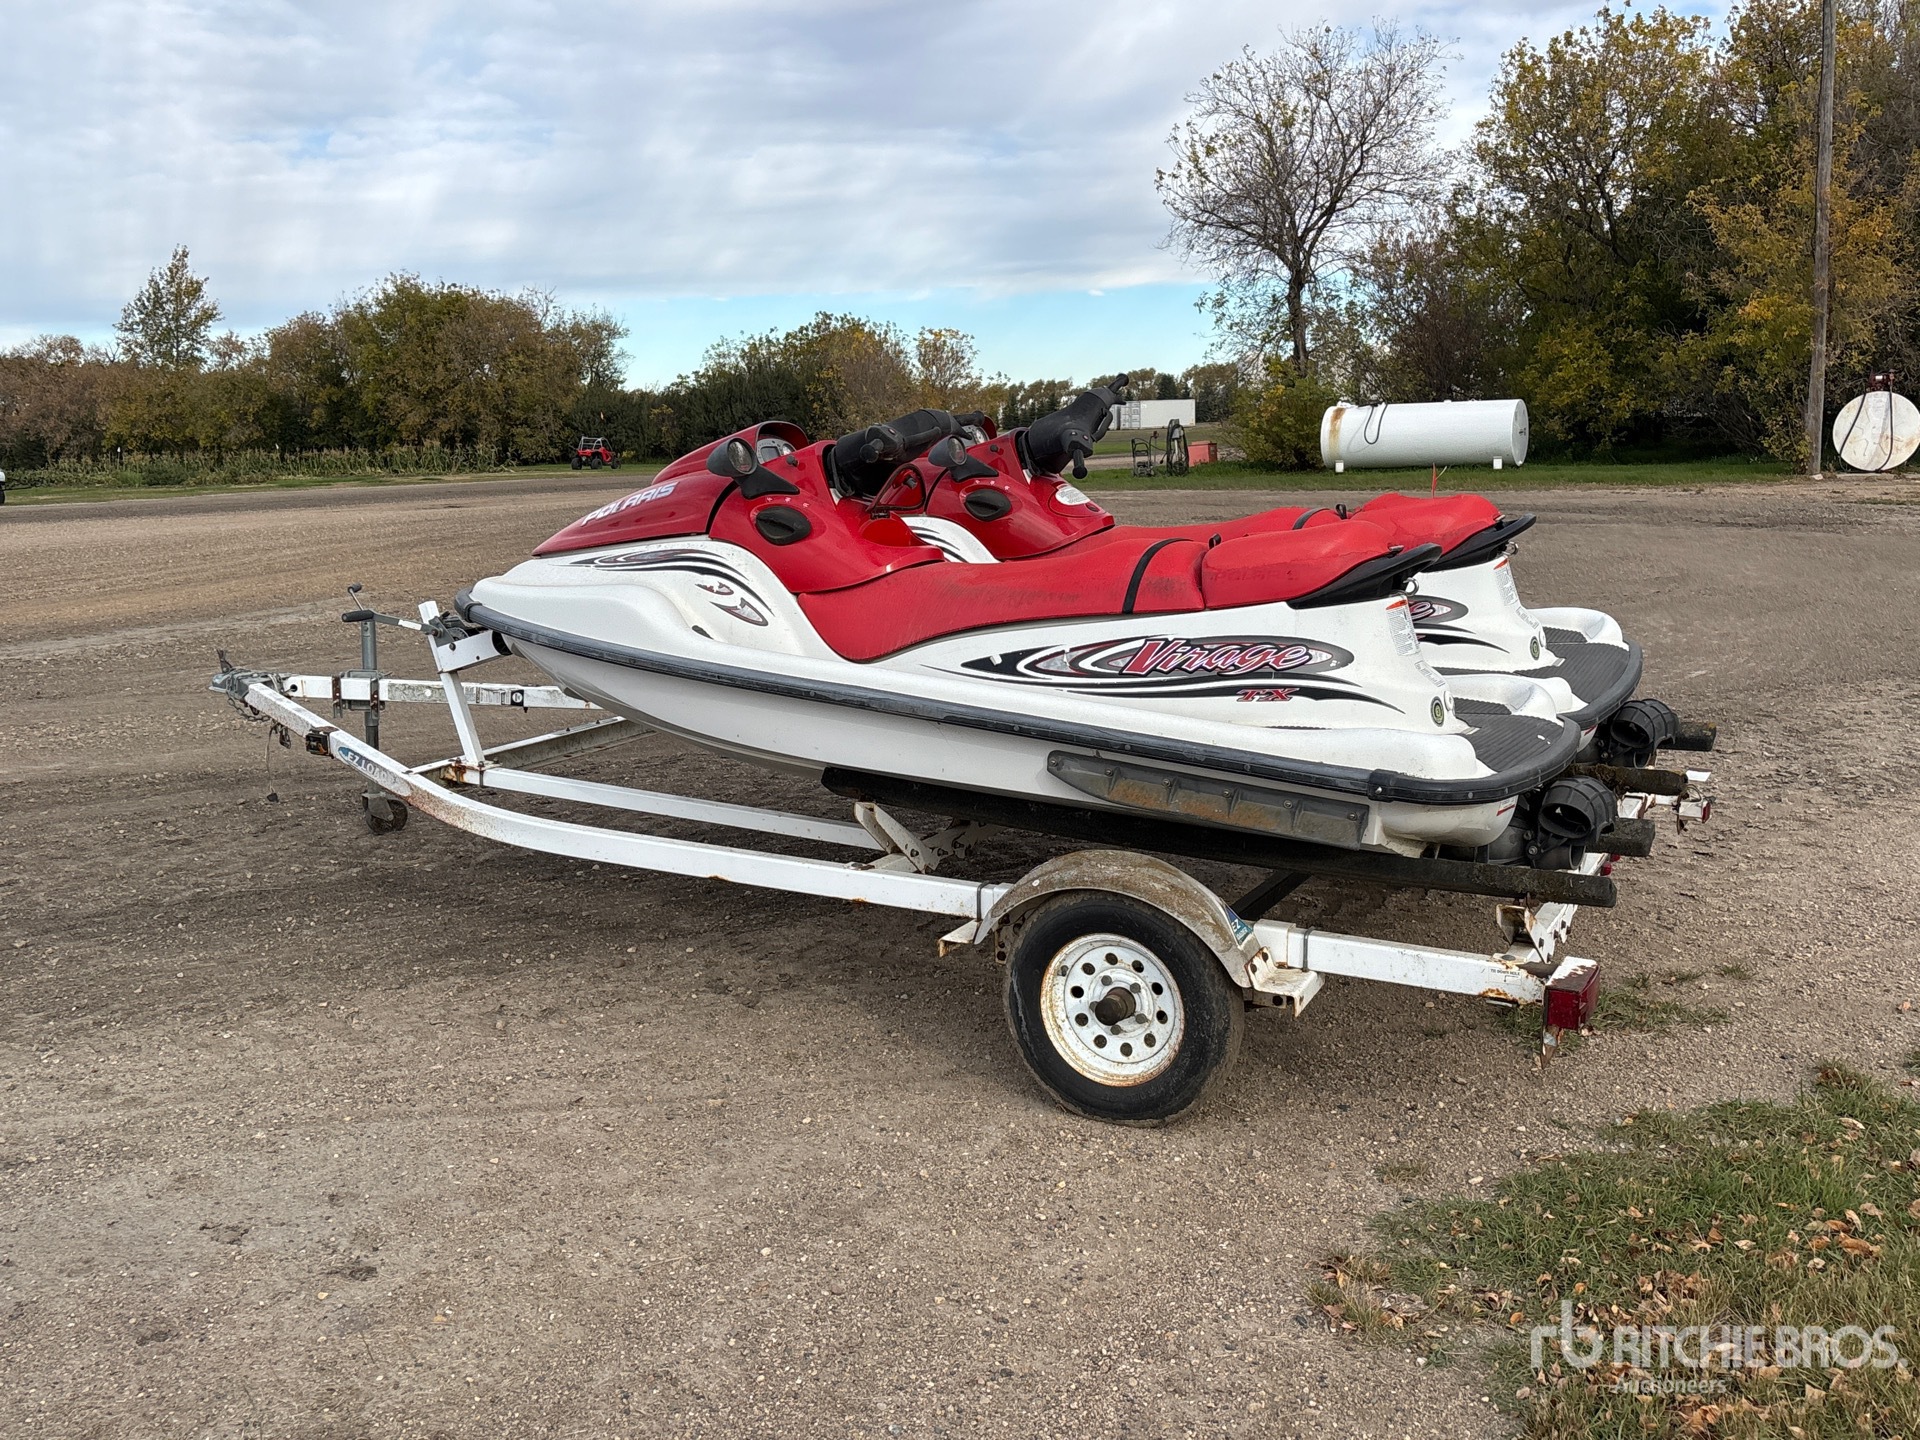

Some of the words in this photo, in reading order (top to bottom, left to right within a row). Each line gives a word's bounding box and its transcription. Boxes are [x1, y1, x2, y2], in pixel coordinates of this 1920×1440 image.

[580, 481, 680, 527] POLARIS
[1119, 638, 1310, 677] Virage
[1236, 687, 1300, 702] TX
[347, 751, 360, 766] EZ
